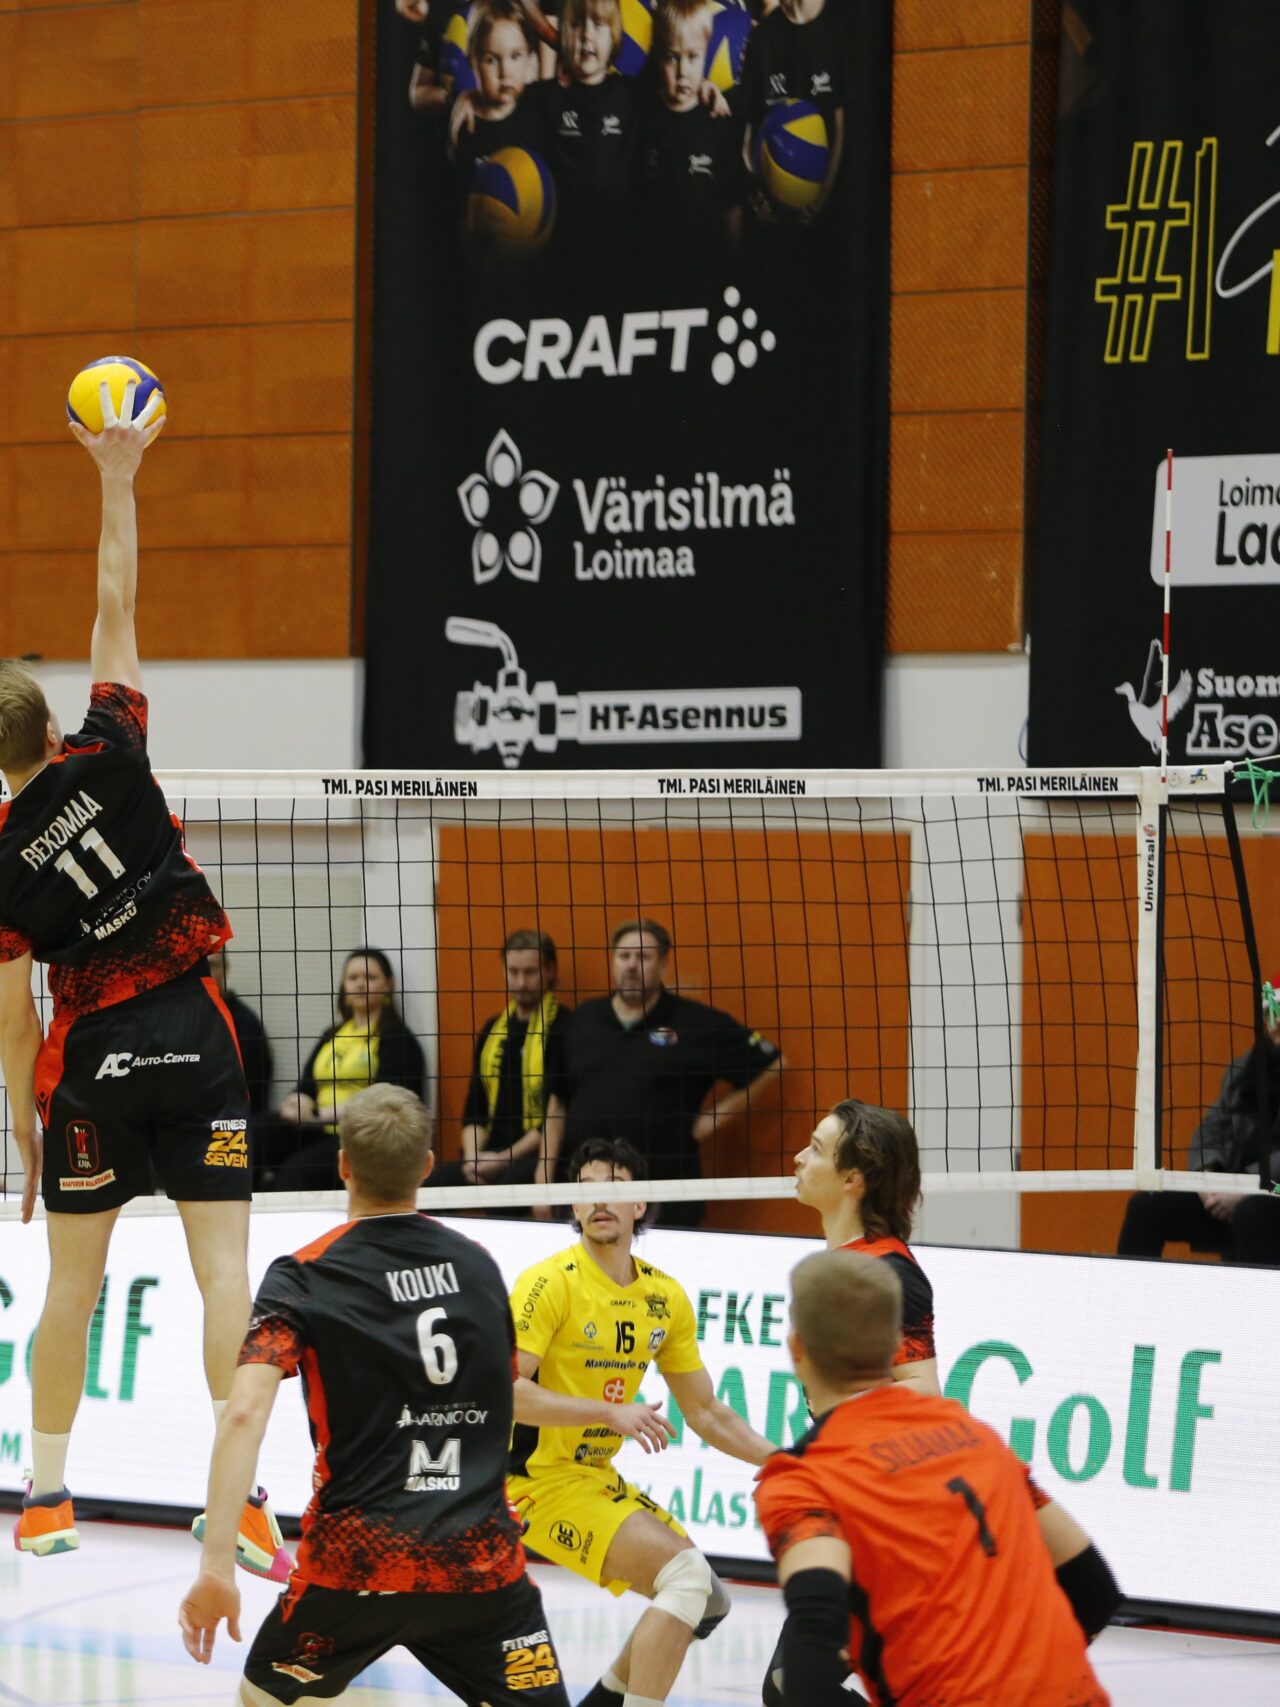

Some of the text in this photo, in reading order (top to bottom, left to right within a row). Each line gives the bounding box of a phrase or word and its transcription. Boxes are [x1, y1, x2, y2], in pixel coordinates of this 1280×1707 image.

[1094, 136, 1218, 363] #1
[473, 307, 709, 385] CRAFT
[573, 467, 796, 535] Värisilmä
[573, 539, 696, 581] Loimaa
[590, 703, 787, 731] HT-Asennus
[322, 777, 478, 798] TMI. PASI MERILÄINEN
[657, 776, 806, 796] TMI. PASI MERILÄINEN
[977, 773, 1119, 793] TMI. PASI MERILÄINEN
[20, 790, 104, 871] REKOMAA
[54, 826, 127, 900] 11
[1144, 839, 1155, 912] Universal
[94, 905, 138, 940] MASKU
[95, 1052, 133, 1080] AC
[207, 1131, 248, 1153] 24
[211, 1119, 247, 1131] FITNES
[203, 1151, 248, 1169] SEVEN
[385, 1262, 461, 1302] KOUKI
[416, 1306, 458, 1385] 6
[615, 1320, 635, 1354] 16
[946, 1476, 998, 1558] 1
[504, 1643, 555, 1675] 24
[506, 1668, 560, 1690] SEVEN
